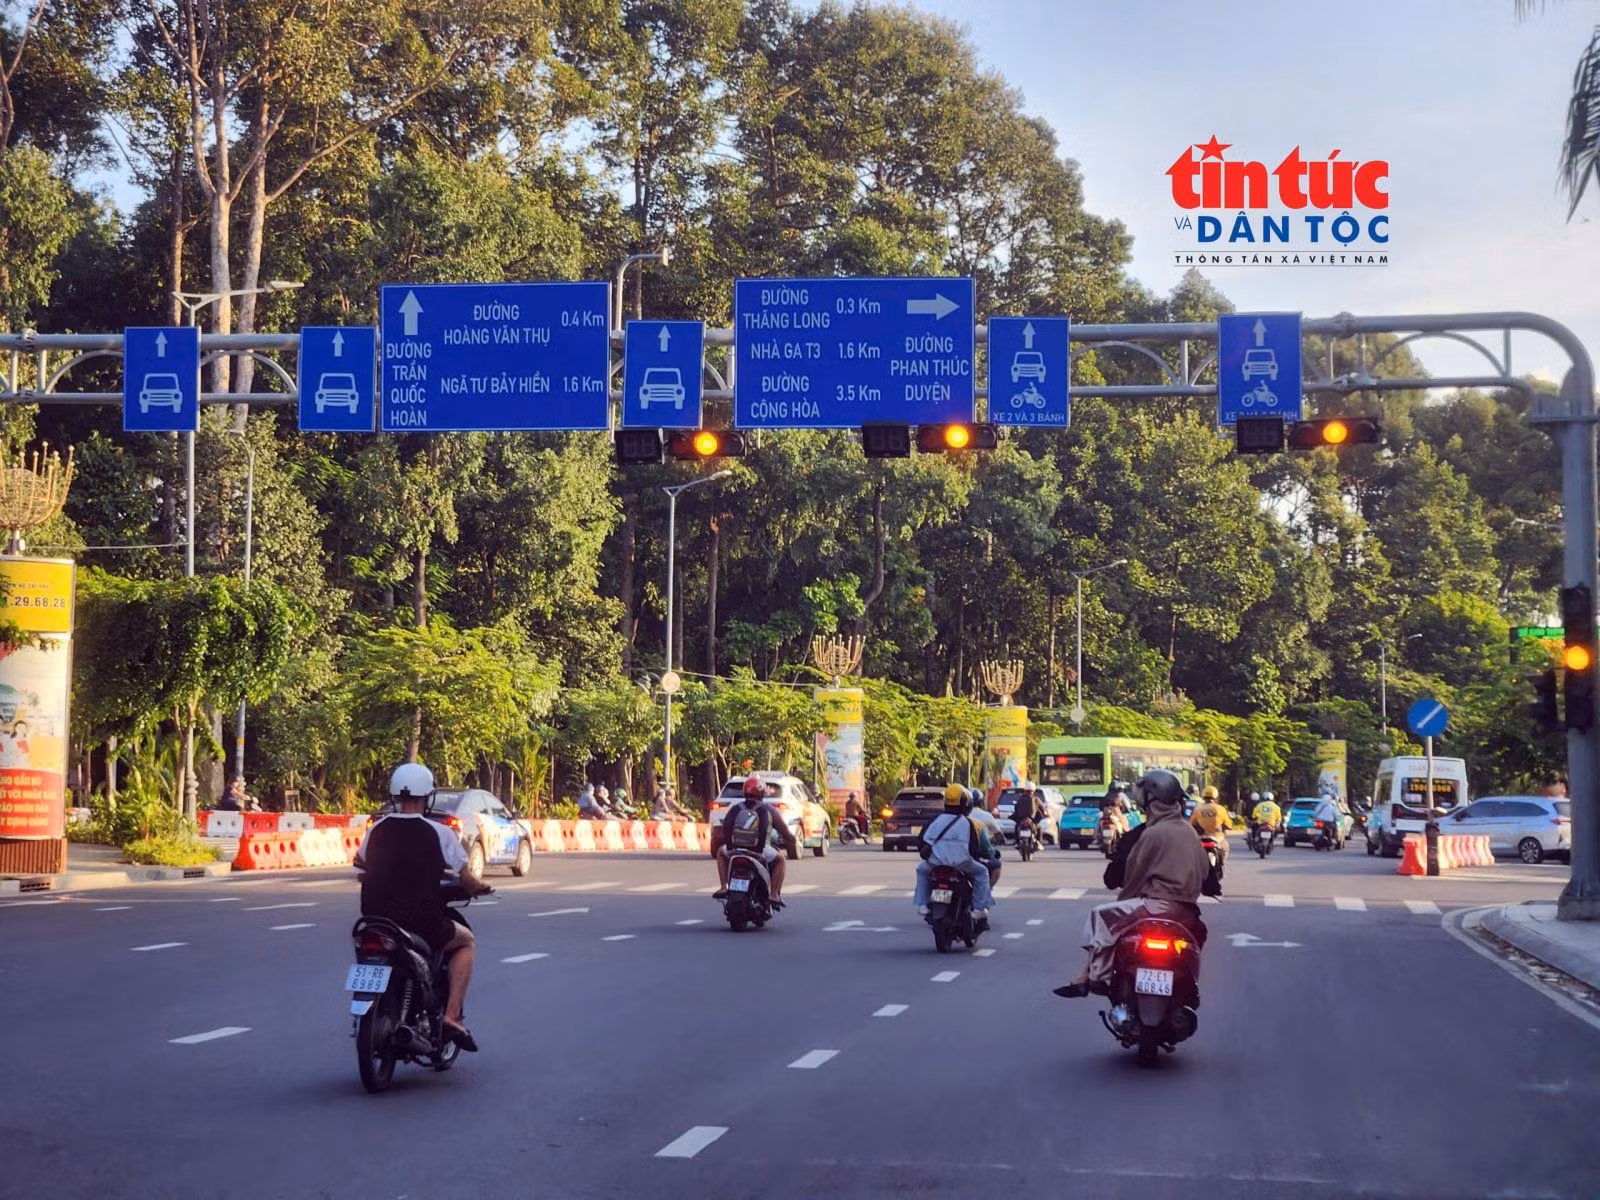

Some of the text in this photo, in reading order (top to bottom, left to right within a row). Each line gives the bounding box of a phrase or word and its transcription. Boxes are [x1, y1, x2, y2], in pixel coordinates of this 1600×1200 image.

[761, 287, 809, 306] ĐƯỜNG
[836, 298, 881, 314] 0.3 Km
[473, 300, 520, 321] ĐƯỜNG
[561, 311, 605, 327] 0.4 Km
[743, 310, 830, 329] THĂNG LONG
[444, 326, 550, 348] HOÀNG VĂN THỤ
[905, 334, 953, 353] ĐƯỜNG
[386, 339, 432, 359] ĐƯỜNG
[751, 340, 821, 359] NHÀ GA T3
[838, 343, 881, 359] 1.6 Km
[392, 359, 427, 381] TRẦN
[890, 356, 969, 376] PHAN THÚC
[441, 371, 550, 394] NGÃ TƯ BẢY HIỀN
[563, 376, 604, 393] 1.6 Km
[762, 373, 810, 392] ĐƯỜNG
[391, 383, 426, 404] QUỐC
[836, 385, 881, 401] 3.5 Km
[905, 381, 951, 405] DUYỆN
[391, 407, 427, 426] HOÀN
[751, 399, 820, 422] CỘNG HÒA
[993, 410, 1065, 423] XE 2 VÀ 3 BÁNH
